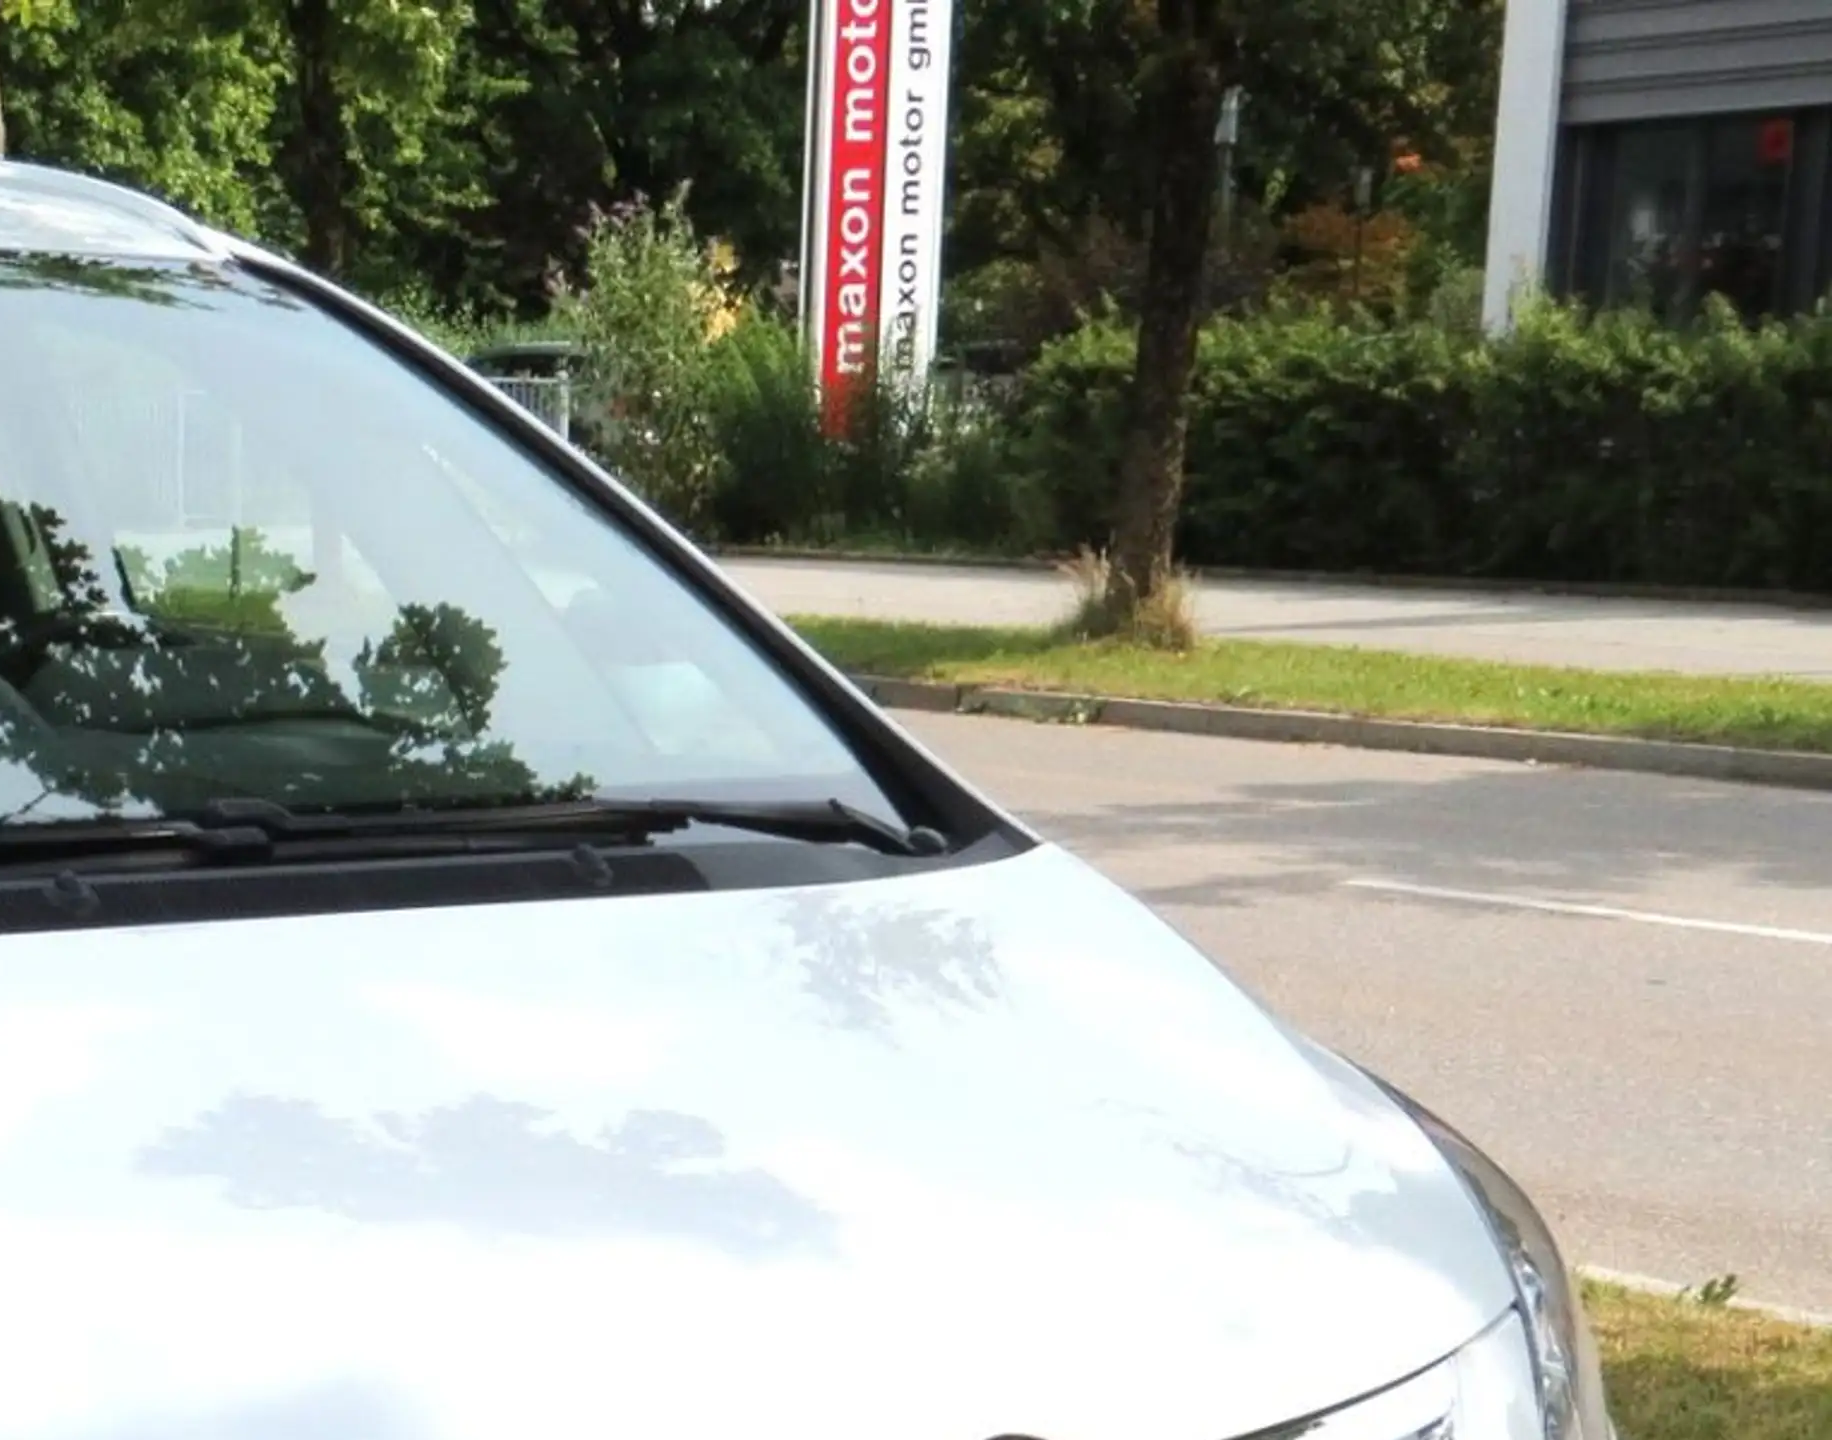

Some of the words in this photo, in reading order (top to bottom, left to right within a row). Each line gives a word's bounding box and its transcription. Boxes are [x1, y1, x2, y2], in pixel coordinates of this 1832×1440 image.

[904, 0, 932, 70] gm
[899, 90, 924, 215] motor
[836, 169, 872, 374] maxon
[894, 234, 919, 369] maxon
